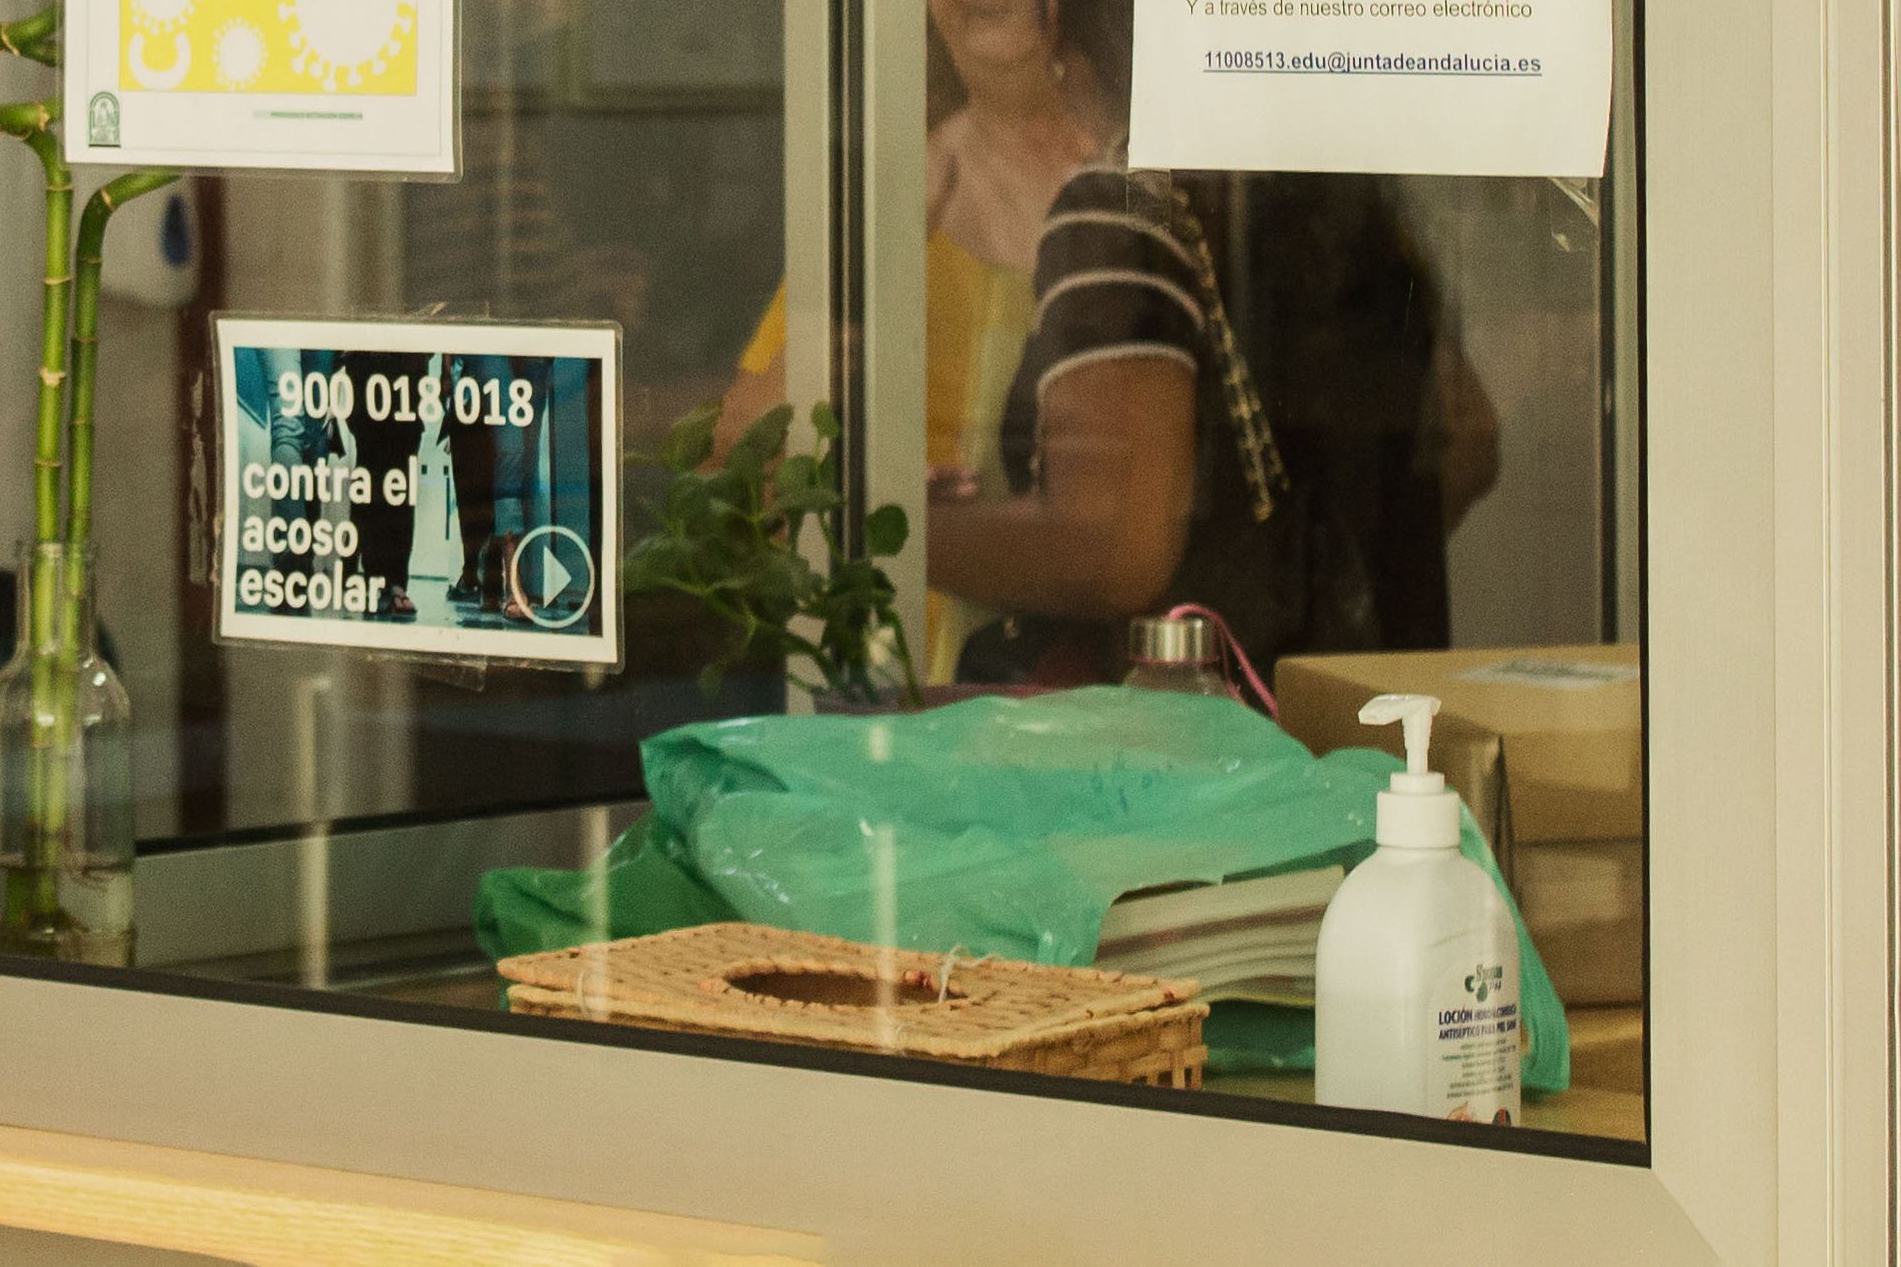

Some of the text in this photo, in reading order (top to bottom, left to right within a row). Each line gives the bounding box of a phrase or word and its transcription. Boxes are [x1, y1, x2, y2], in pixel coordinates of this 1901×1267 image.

[1204, 2, 1215, 16] a
[1300, 0, 1364, 17] nuestro
[1369, 2, 1427, 17] correo
[1205, 50, 1542, 77] 11008513.edu@juntadeandalucia.es
[277, 370, 534, 428] 900 018 018
[243, 454, 419, 507] contra el
[242, 515, 359, 557] acoso
[239, 559, 386, 614] escolar
[1438, 1008, 1473, 1025] LOCIÓN
